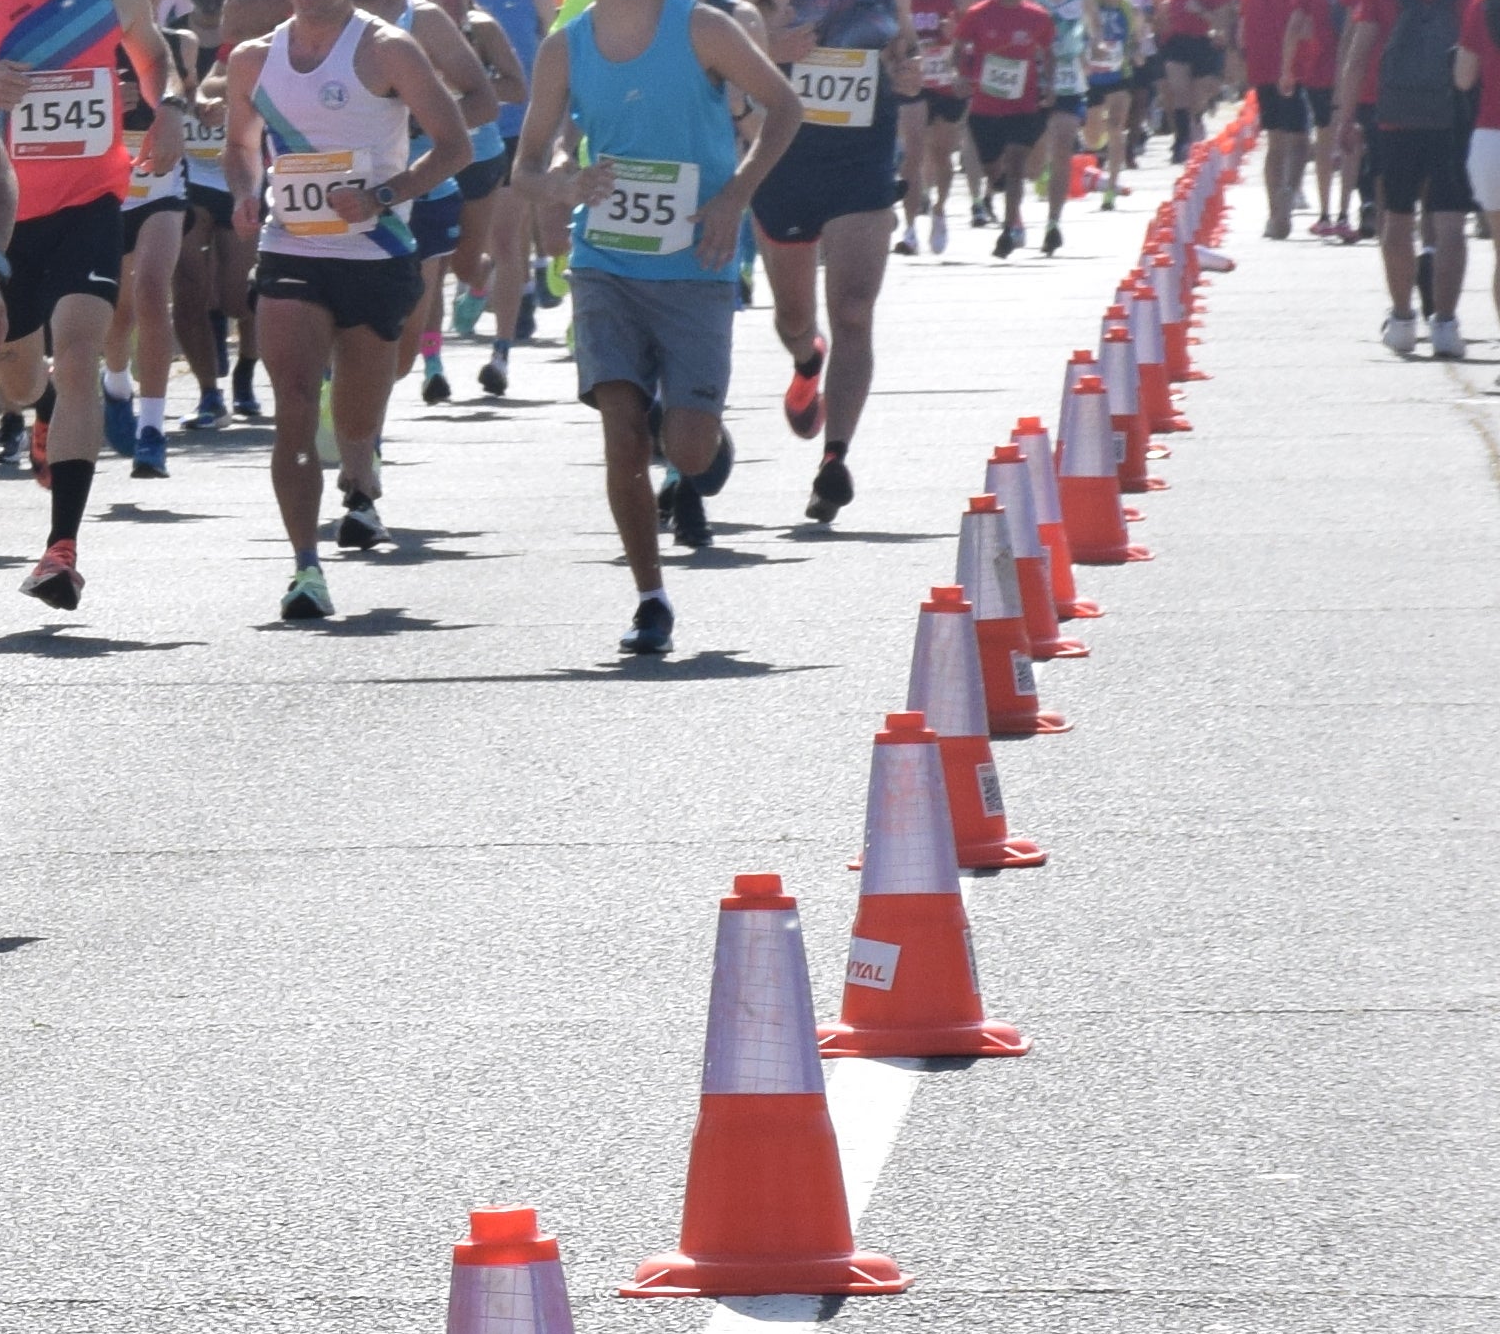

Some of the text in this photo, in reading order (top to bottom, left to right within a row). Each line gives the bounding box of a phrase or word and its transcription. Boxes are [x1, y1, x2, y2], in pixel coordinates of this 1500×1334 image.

[799, 73, 871, 102] 1076
[20, 99, 106, 132] 1545
[608, 189, 675, 225] 355
